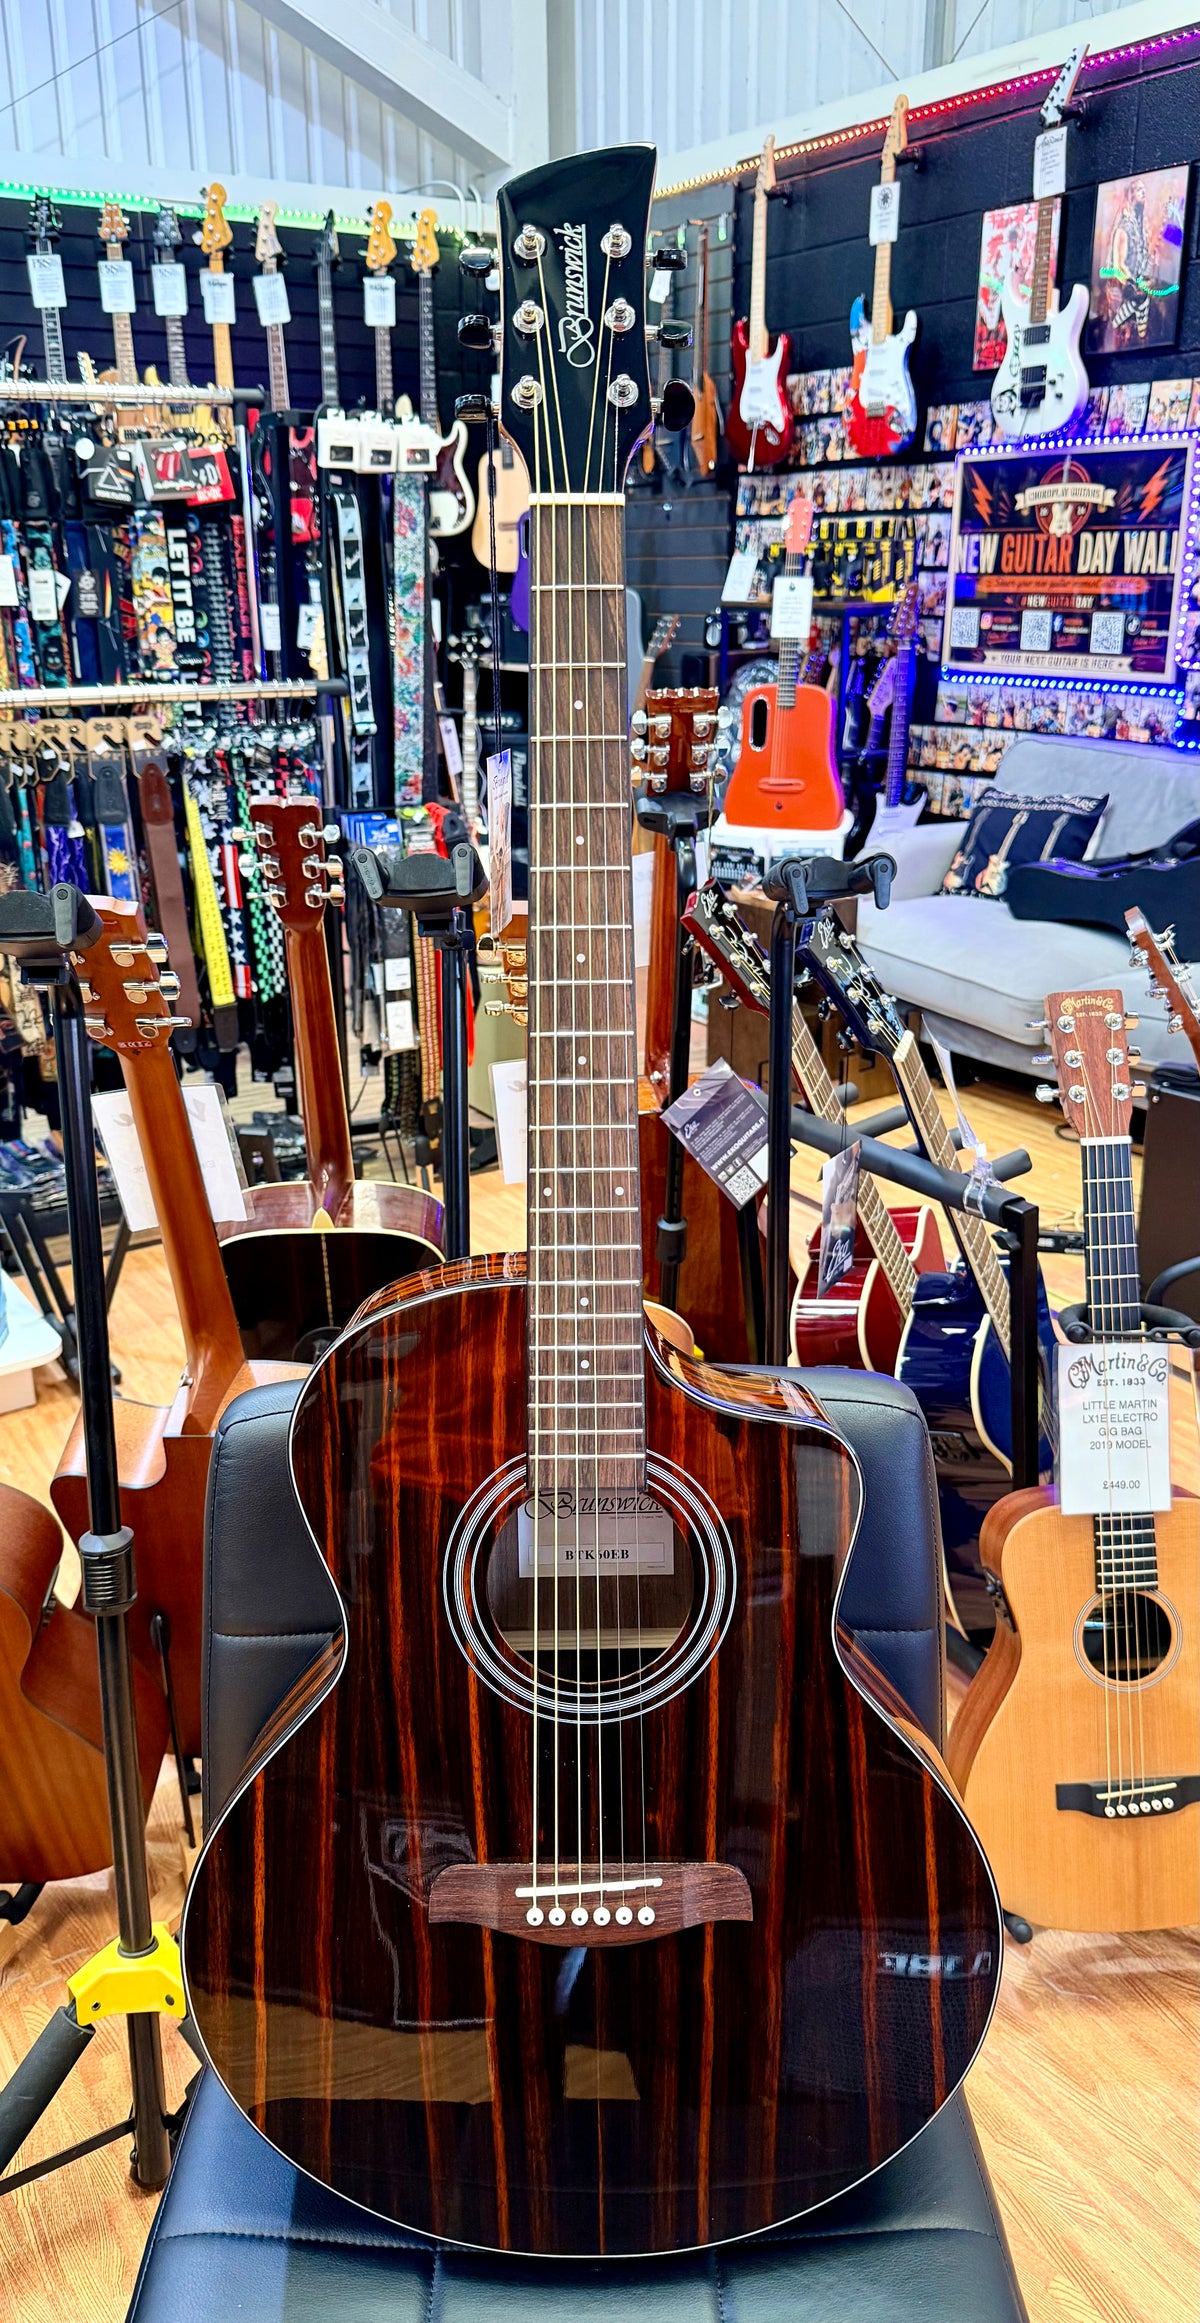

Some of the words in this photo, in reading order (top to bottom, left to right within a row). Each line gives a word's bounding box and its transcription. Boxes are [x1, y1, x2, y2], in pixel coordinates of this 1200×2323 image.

[553, 222, 595, 368] Brunswick
[167, 528, 190, 577] LET
[955, 532, 999, 574] NEW
[1001, 533, 1074, 574] GUITAR
[1077, 531, 1120, 574] DAY
[172, 578, 194, 608] IT
[174, 608, 196, 643] BE
[1000, 653, 1021, 664] YOUR
[1024, 655, 1046, 666] NEXT
[1048, 656, 1078, 667] GUITAR
[1080, 657, 1089, 668] IS
[1092, 658, 1115, 670] HERE
[1096, 1378, 1119, 1387] EST.
[1122, 1377, 1146, 1386] 1833
[1082, 1400, 1116, 1410] LITTLE
[1119, 1399, 1158, 1409] MARTIN
[1110, 1412, 1158, 1423] ELECTRO
[1098, 1427, 1118, 1436] GG
[1121, 1426, 1142, 1436] BAG
[1090, 1440, 1112, 1450] 2019
[1116, 1439, 1152, 1449] MODEL
